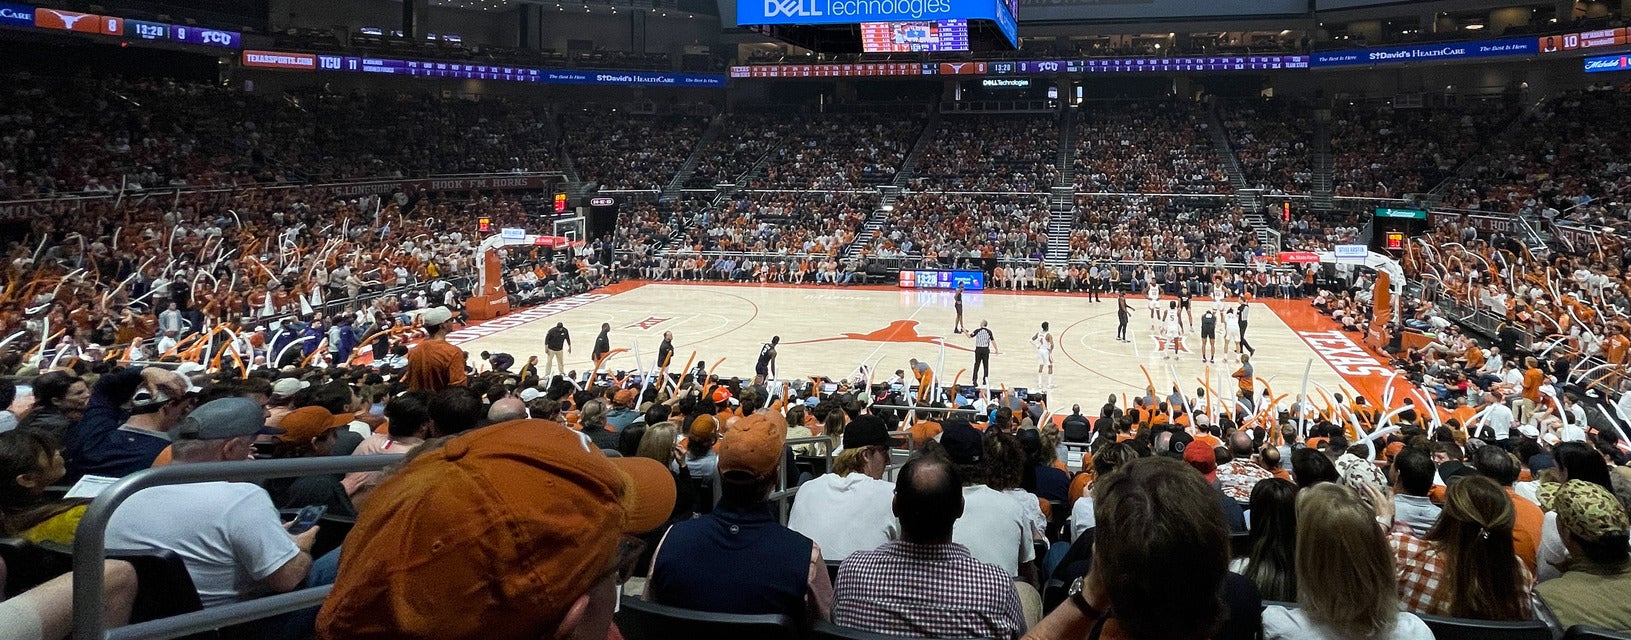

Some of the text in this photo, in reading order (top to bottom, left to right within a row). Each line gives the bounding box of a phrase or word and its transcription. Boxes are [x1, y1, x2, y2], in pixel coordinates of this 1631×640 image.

[0, 8, 32, 20] CARE
[764, 0, 951, 17] DELL Technologies
[108, 20, 116, 31] 8
[177, 28, 185, 39] 9
[201, 31, 232, 45] TCU
[1564, 36, 1578, 48] 10
[319, 57, 341, 69] TCU
[349, 59, 357, 70] 11
[1038, 61, 1059, 72] TCU
[432, 180, 463, 190] HOOK
[493, 178, 528, 187] HORNS
[942, 272, 948, 281] 9
[445, 293, 612, 346] ONGHORNS
[1298, 330, 1394, 376] TEXAS
